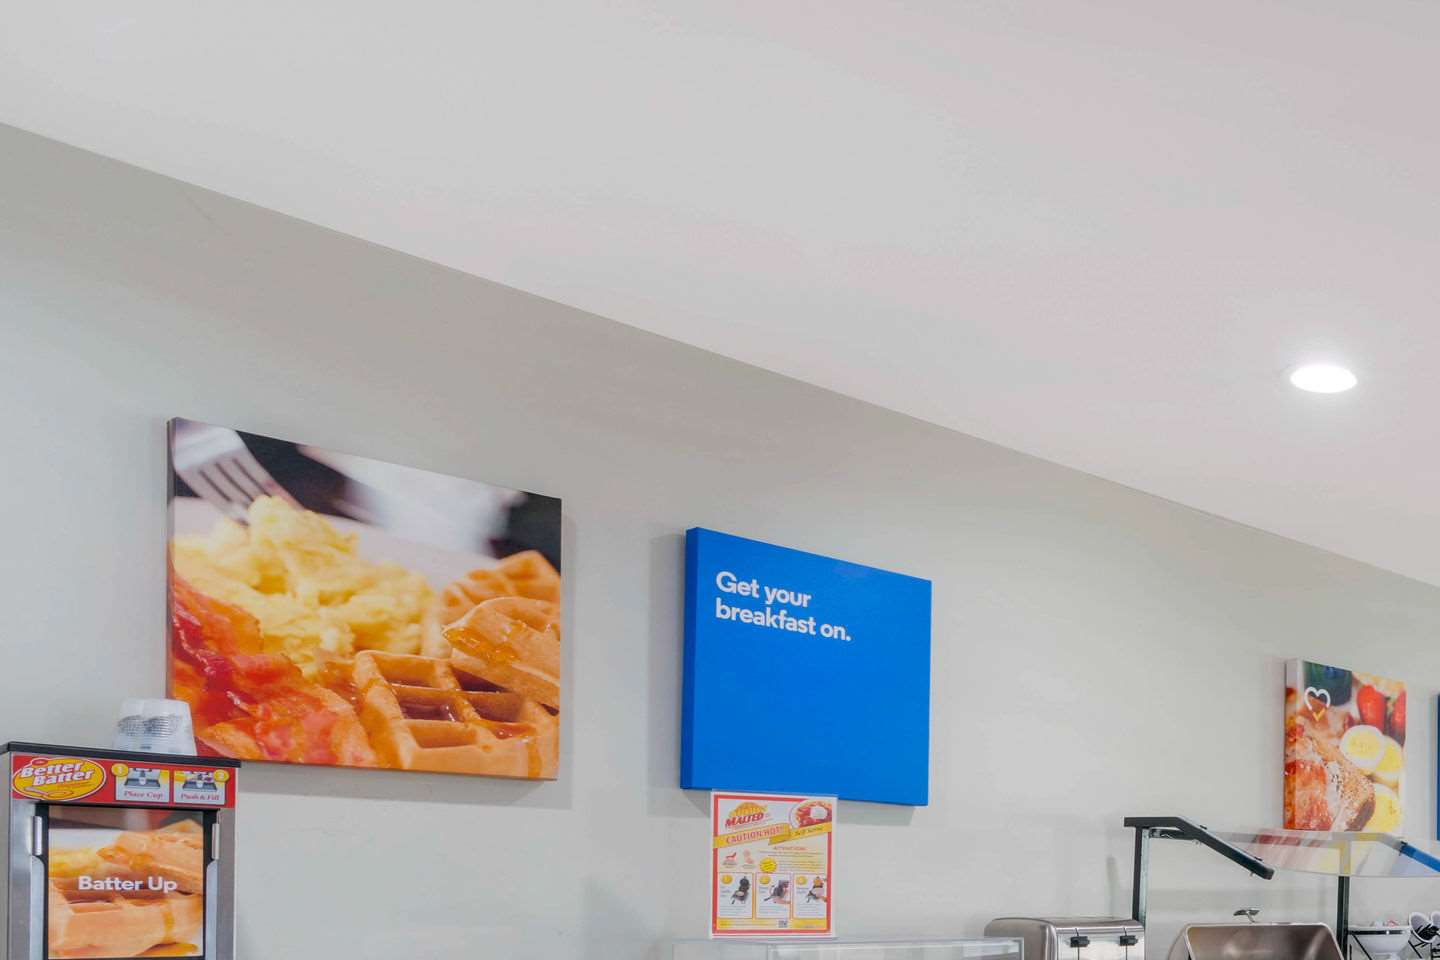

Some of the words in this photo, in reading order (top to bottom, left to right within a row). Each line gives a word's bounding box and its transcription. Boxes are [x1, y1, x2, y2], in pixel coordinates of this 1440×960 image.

[715, 570, 760, 598] Get
[764, 584, 812, 608] your
[715, 597, 816, 635] breakfast
[819, 623, 852, 642] on.
[20, 761, 83, 778] Better
[33, 769, 94, 786] Batter
[78, 876, 143, 890] Batter
[147, 876, 177, 893] Up
